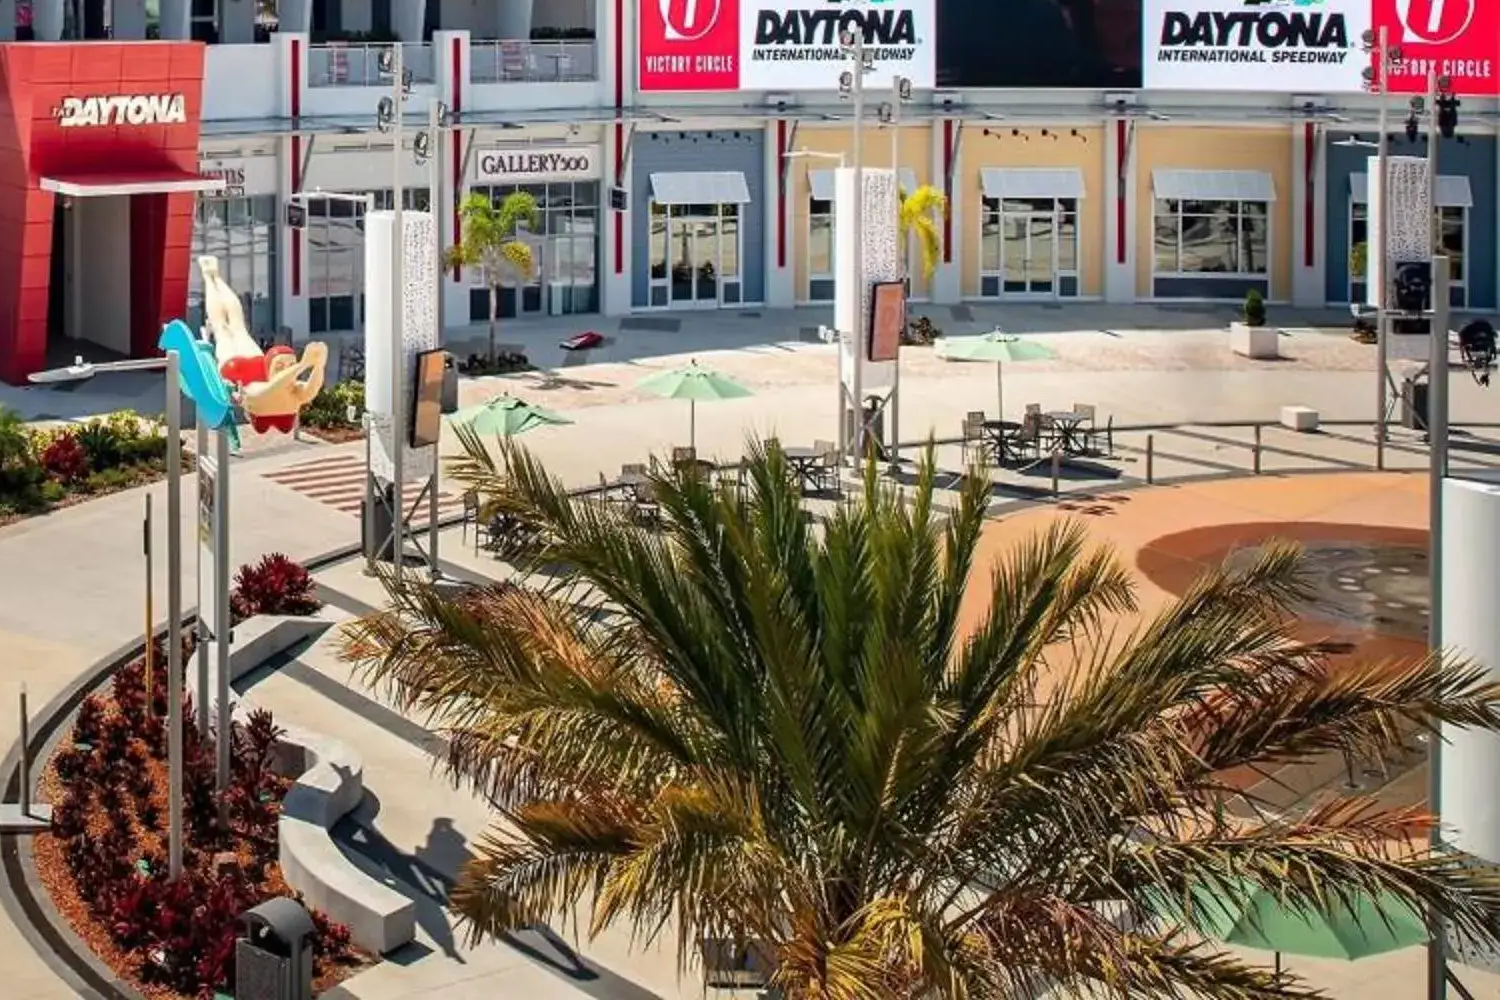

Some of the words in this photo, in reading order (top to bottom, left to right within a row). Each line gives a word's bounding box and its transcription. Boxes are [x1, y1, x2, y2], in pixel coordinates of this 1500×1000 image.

[754, 9, 916, 45] DAYTONA
[1160, 11, 1348, 48] DAYTONA
[645, 55, 691, 73] VICTORY
[695, 55, 733, 73] CIRCLE
[851, 48, 916, 61] EDWAY
[1157, 49, 1267, 64] INTERNATIONAL
[1271, 50, 1348, 65] SPEEDWAY
[1383, 58, 1437, 76] CTORY
[1442, 59, 1491, 77] CIRCLE
[59, 94, 187, 127] DAYTONA
